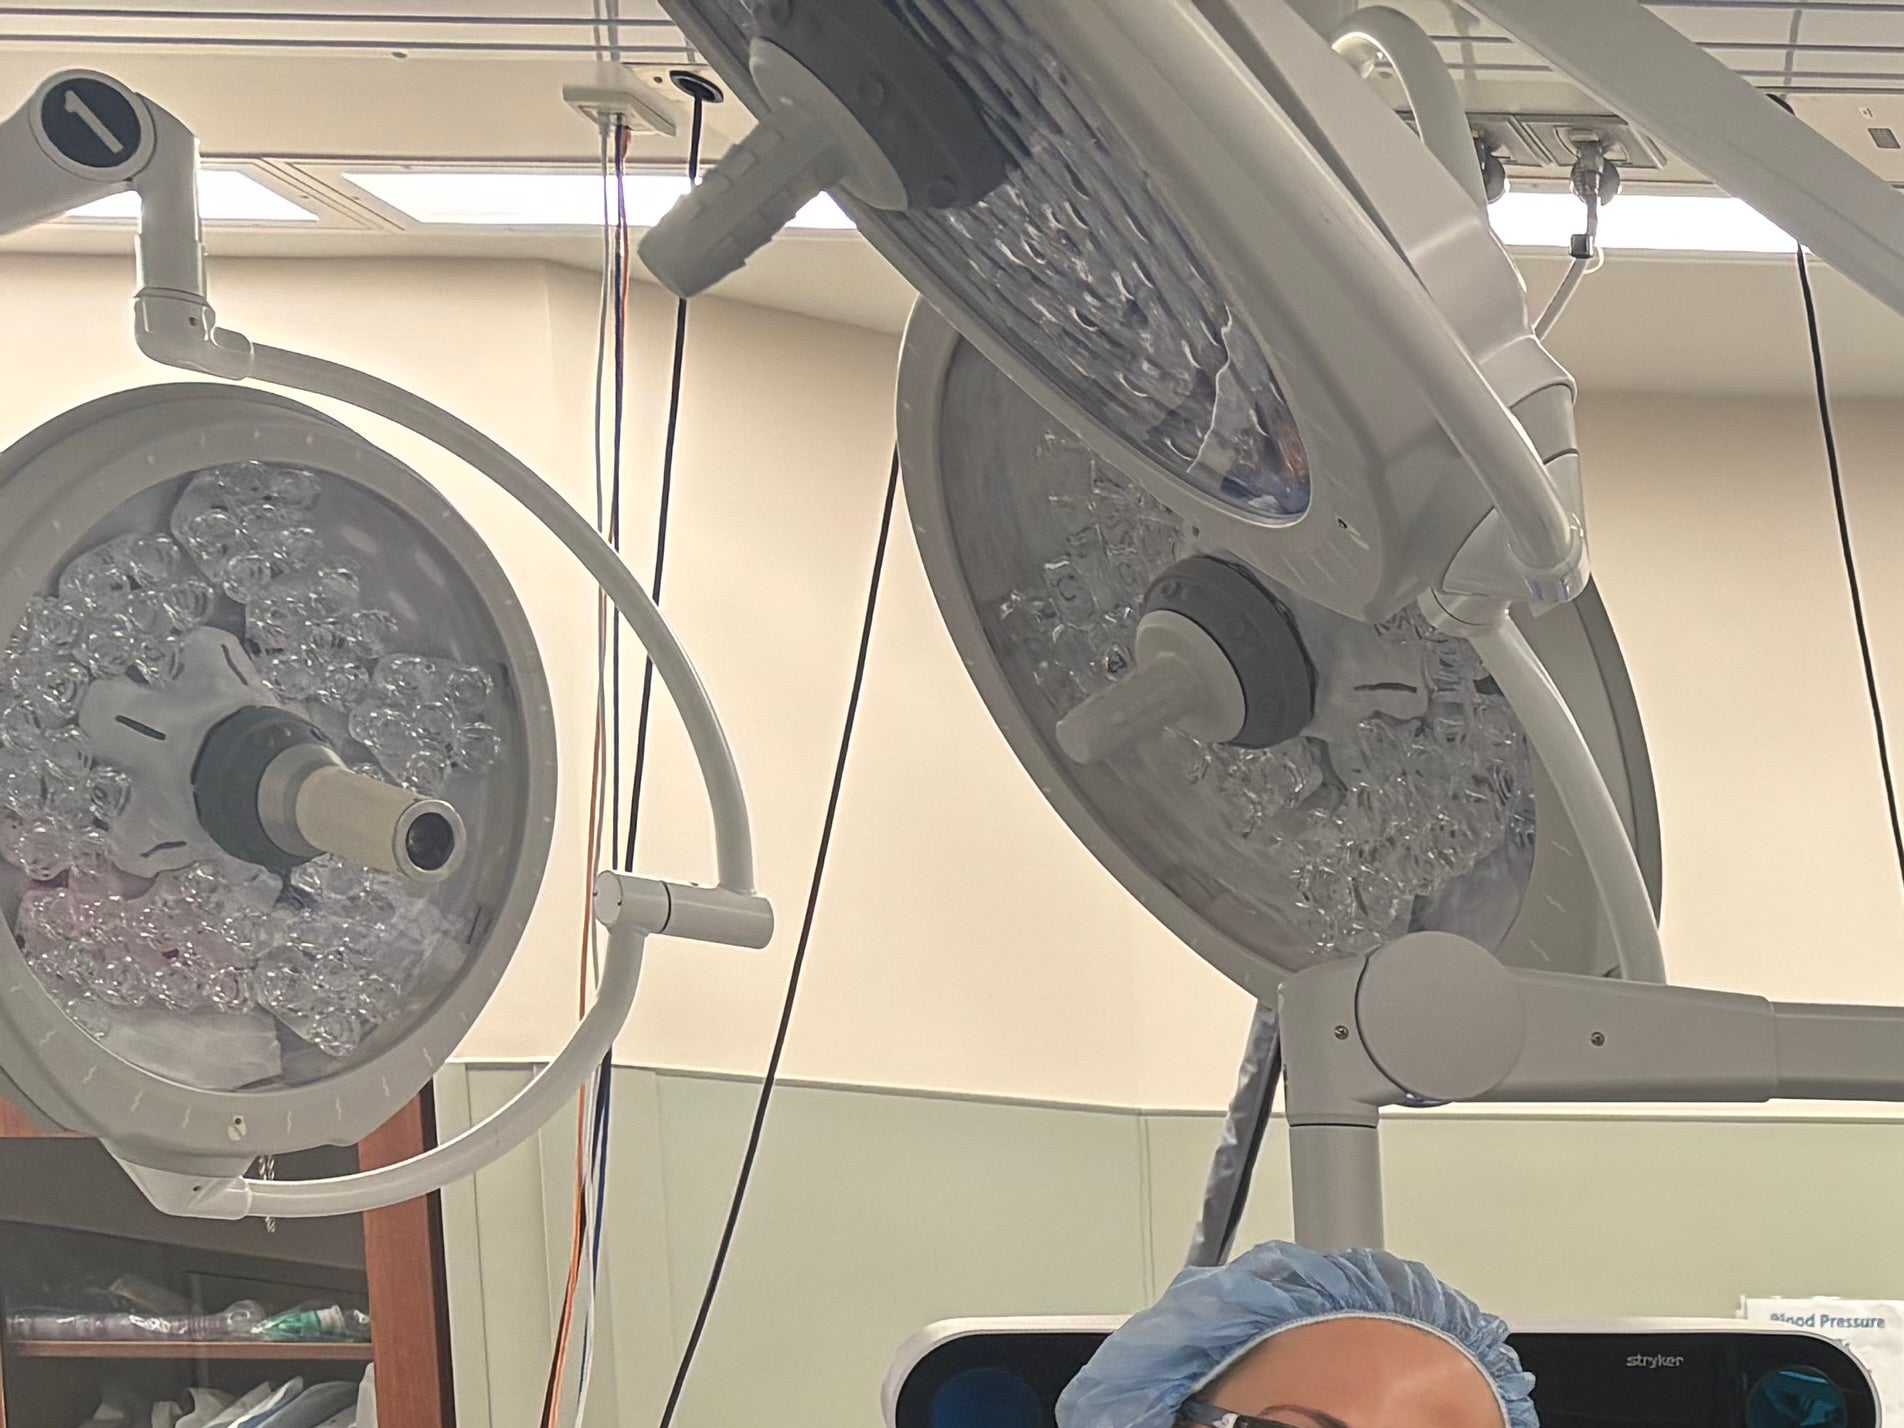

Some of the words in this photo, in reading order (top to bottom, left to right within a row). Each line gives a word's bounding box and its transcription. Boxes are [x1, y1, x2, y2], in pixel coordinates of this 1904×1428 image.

[63, 90, 124, 156] 1
[1819, 1314, 1886, 1329] Pressure
[1626, 1353, 1684, 1369] stryker
